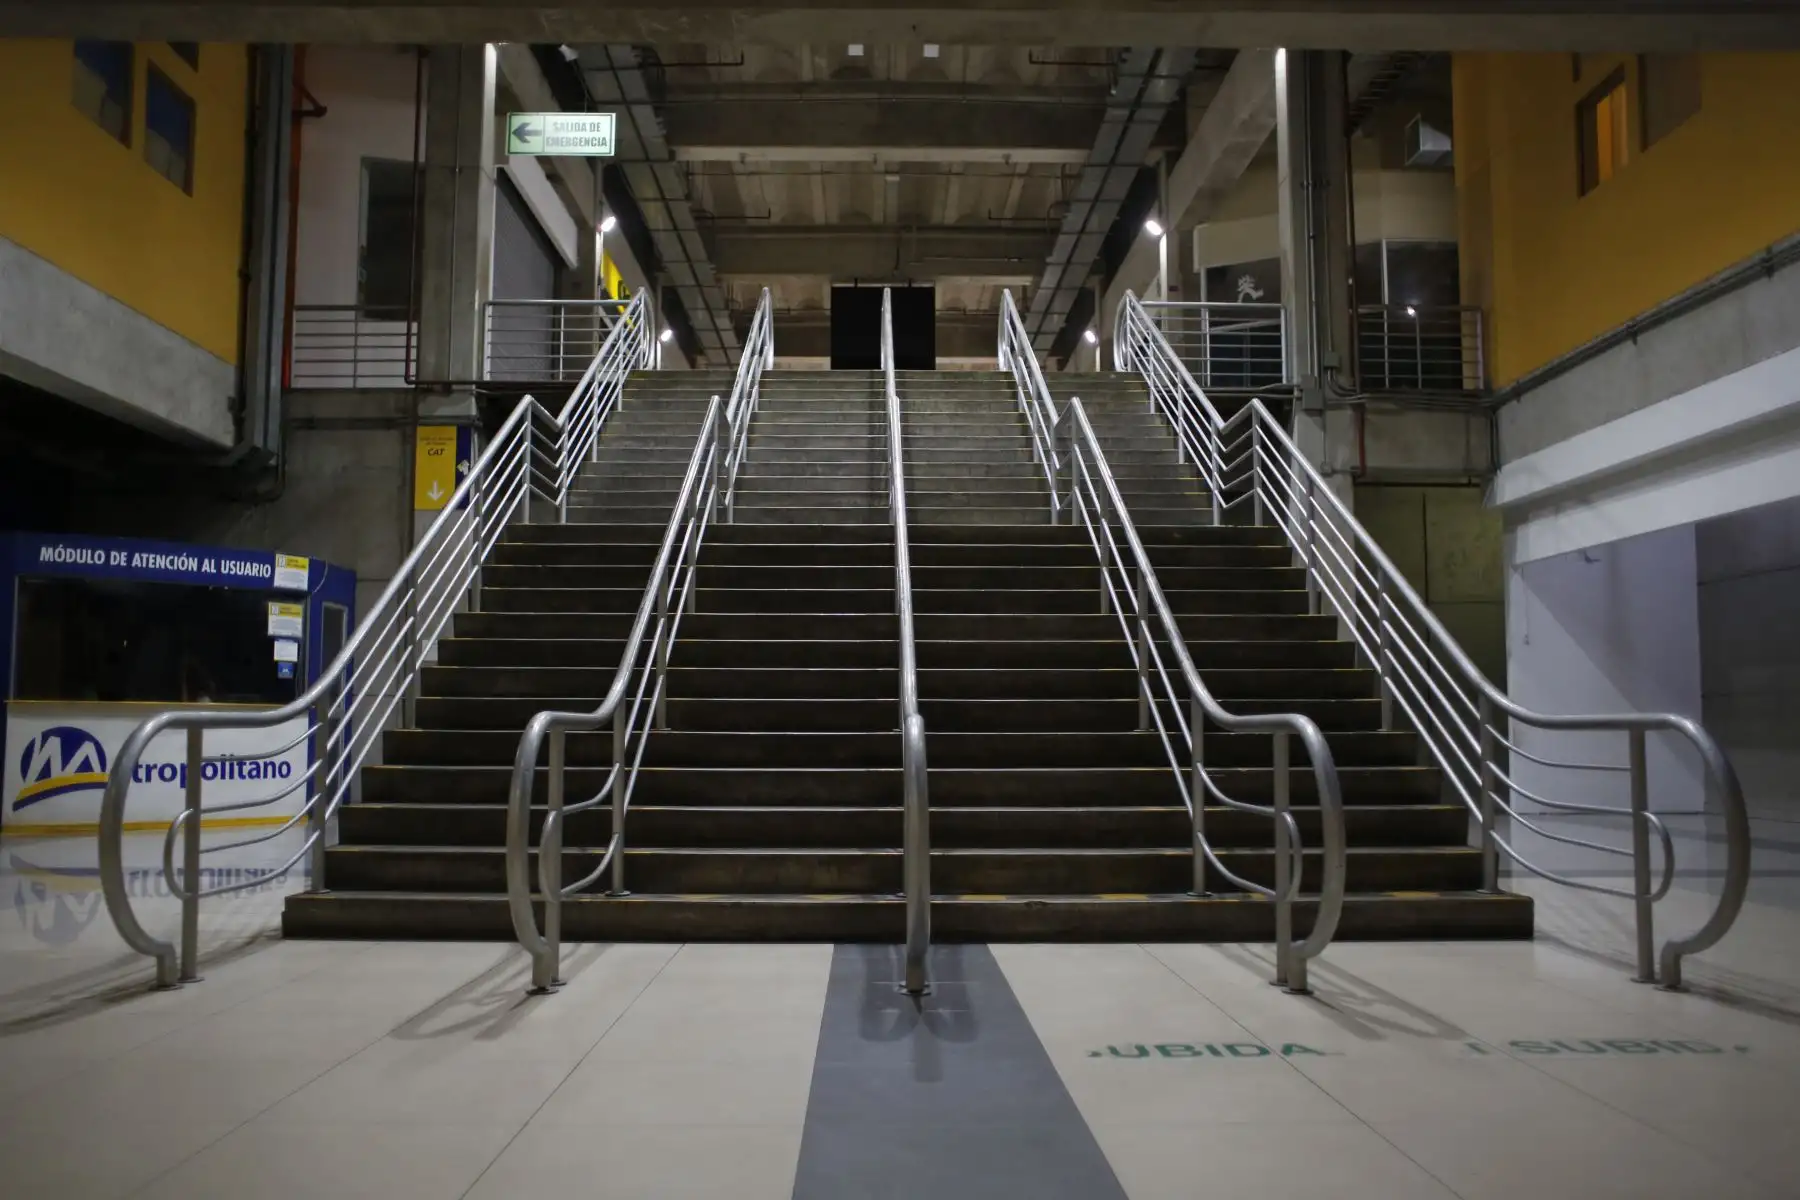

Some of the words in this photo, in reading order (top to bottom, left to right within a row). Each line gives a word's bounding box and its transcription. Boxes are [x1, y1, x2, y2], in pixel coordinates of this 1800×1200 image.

[552, 121, 587, 133] SALIDA
[589, 121, 601, 133] DE
[545, 136, 608, 147] EMERGENCIA
[427, 447, 445, 456] CAT
[39, 544, 106, 565] MÓDULO
[110, 551, 128, 567] DE
[131, 552, 198, 572] ATENCIÓN
[201, 558, 217, 574] AL
[220, 562, 272, 578] USUARIO
[1087, 1042, 1347, 1058] UBIDA
[1508, 1039, 1749, 1054] SUBID
